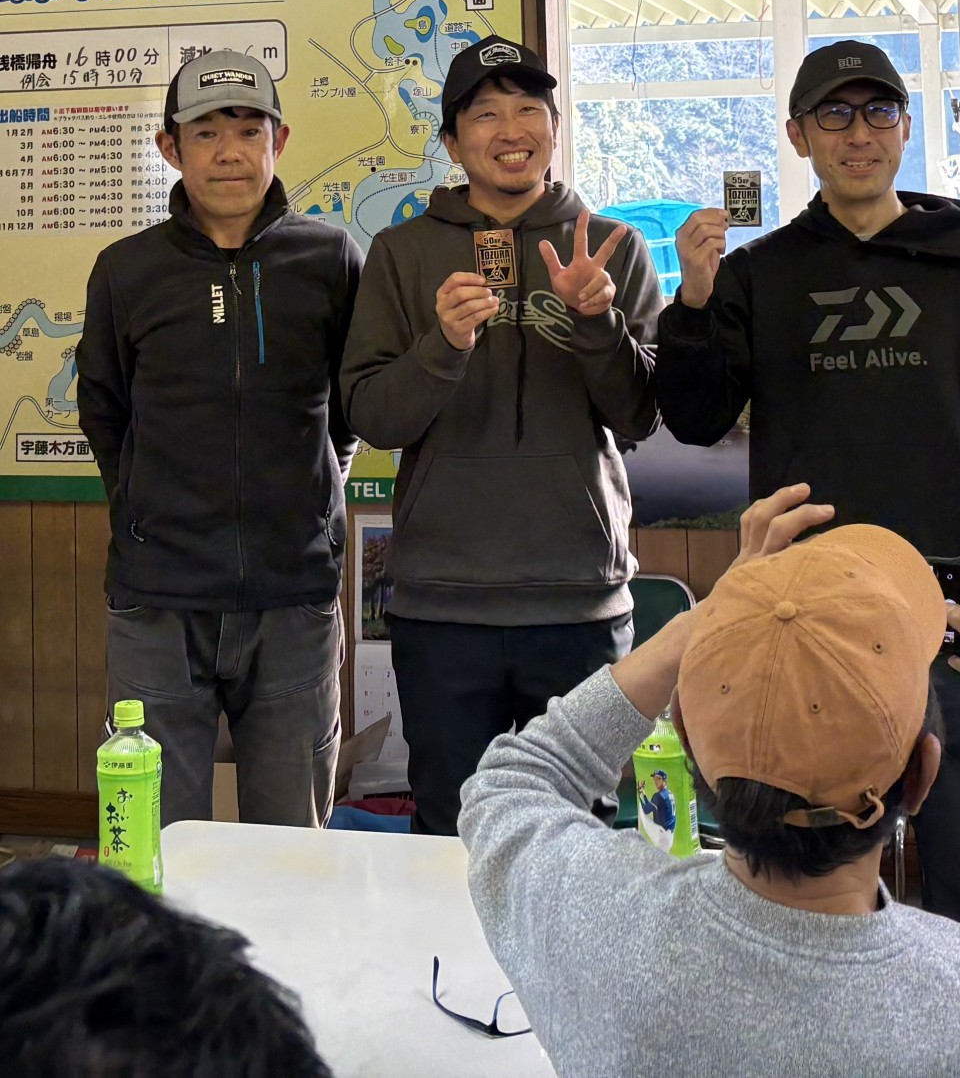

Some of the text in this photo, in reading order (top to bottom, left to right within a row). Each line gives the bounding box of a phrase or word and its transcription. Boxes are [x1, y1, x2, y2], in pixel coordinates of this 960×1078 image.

[418, 20, 427, 29] 島
[445, 22, 472, 32] 道路下
[263, 47, 278, 59] m
[20, 72, 51, 90] 例会
[202, 73, 223, 82] QUIET
[224, 72, 253, 81] WANDER
[311, 77, 329, 87] 上郷
[311, 87, 357, 98] ポンプ小屋
[413, 87, 432, 97] 塚山
[410, 125, 428, 135] 寮下
[20, 142, 33, 150] 3月
[357, 157, 385, 166] 光生園
[379, 172, 416, 182] 光生園下
[20, 182, 33, 190] 8月
[145, 178, 167, 186] 4:00
[323, 182, 351, 192] 光生園
[145, 191, 167, 199] 4:00
[323, 194, 351, 203] ワンド
[729, 188, 758, 200] TOZURA
[146, 205, 167, 213] 3:30
[481, 249, 511, 260] TOZURA
[211, 284, 225, 324] MILLET
[809, 347, 928, 372] Feel Alive.
[21, 441, 90, 455] 宇藤木方面
[351, 482, 386, 498] TEL
[106, 802, 130, 854] お茶
